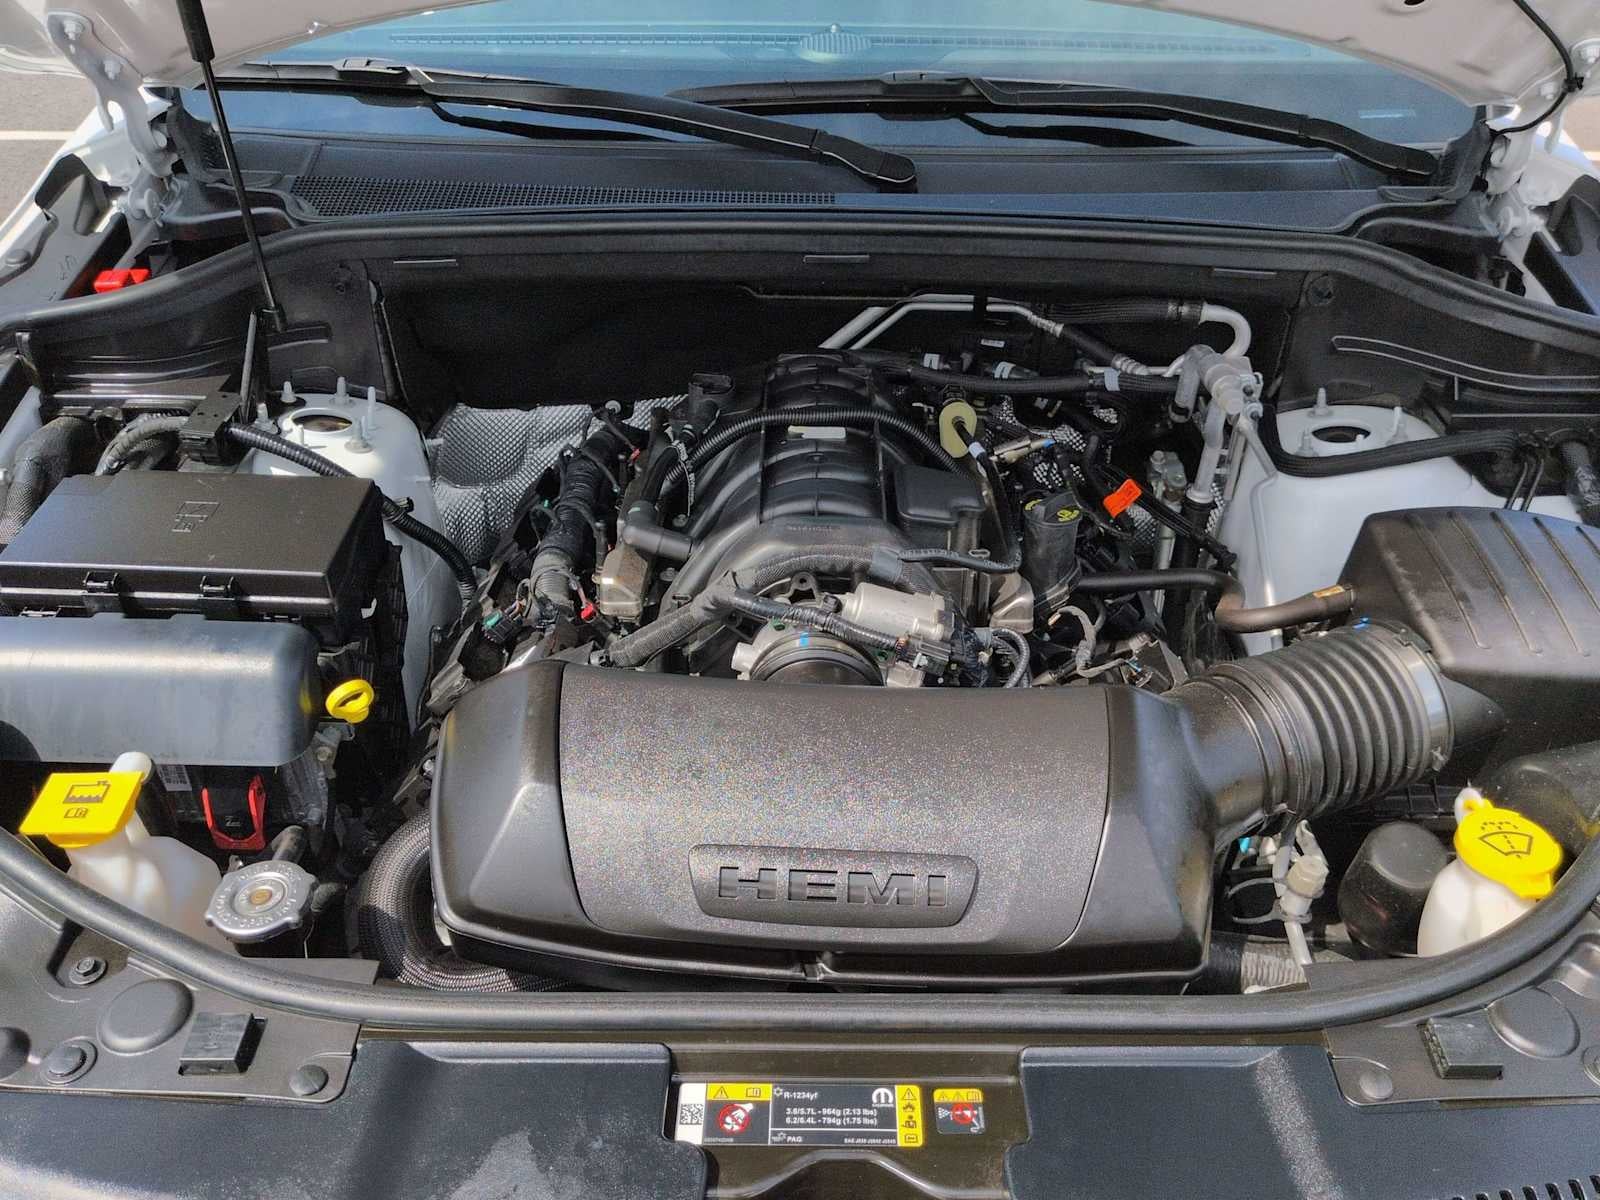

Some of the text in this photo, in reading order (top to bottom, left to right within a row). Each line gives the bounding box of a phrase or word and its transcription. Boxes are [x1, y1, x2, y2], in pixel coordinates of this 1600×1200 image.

[718, 866, 947, 907] HEMI
[783, 1091, 818, 1101] R-1234yf
[822, 1107, 841, 1117] 964g
[842, 1107, 861, 1116] (2.13
[822, 1117, 841, 1126] 794g
[842, 1117, 862, 1126] (1.75
[786, 1135, 803, 1143] PAG
